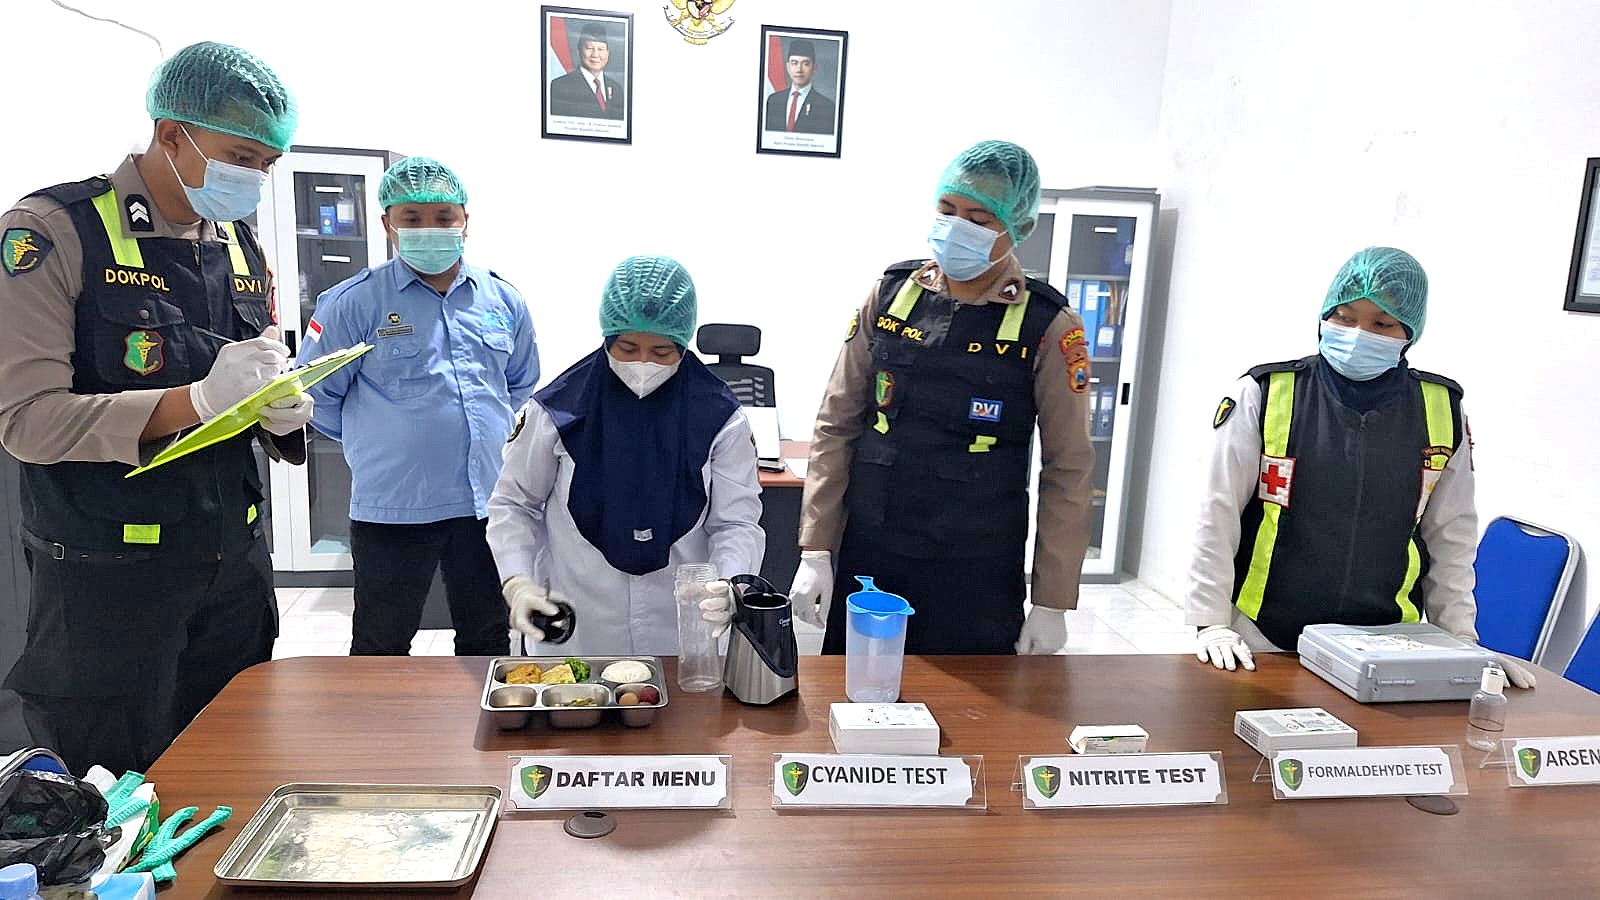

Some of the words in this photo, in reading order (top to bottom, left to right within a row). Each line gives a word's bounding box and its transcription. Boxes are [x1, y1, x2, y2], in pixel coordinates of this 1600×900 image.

[105, 268, 170, 292] DOKPOL
[234, 278, 262, 294] DVI
[901, 326, 922, 341] POL
[972, 401, 1000, 416] DVI
[1546, 748, 1600, 767] ARSEN
[556, 771, 645, 788] DAFTAR
[652, 770, 717, 787] MENU
[811, 766, 898, 784] CYANIDE
[902, 767, 948, 785] TEST
[1068, 769, 1151, 786] NITRITE
[1155, 768, 1206, 784] TEST
[1307, 764, 1412, 779] FORMALDEHYDE
[1414, 763, 1443, 777] TEST
